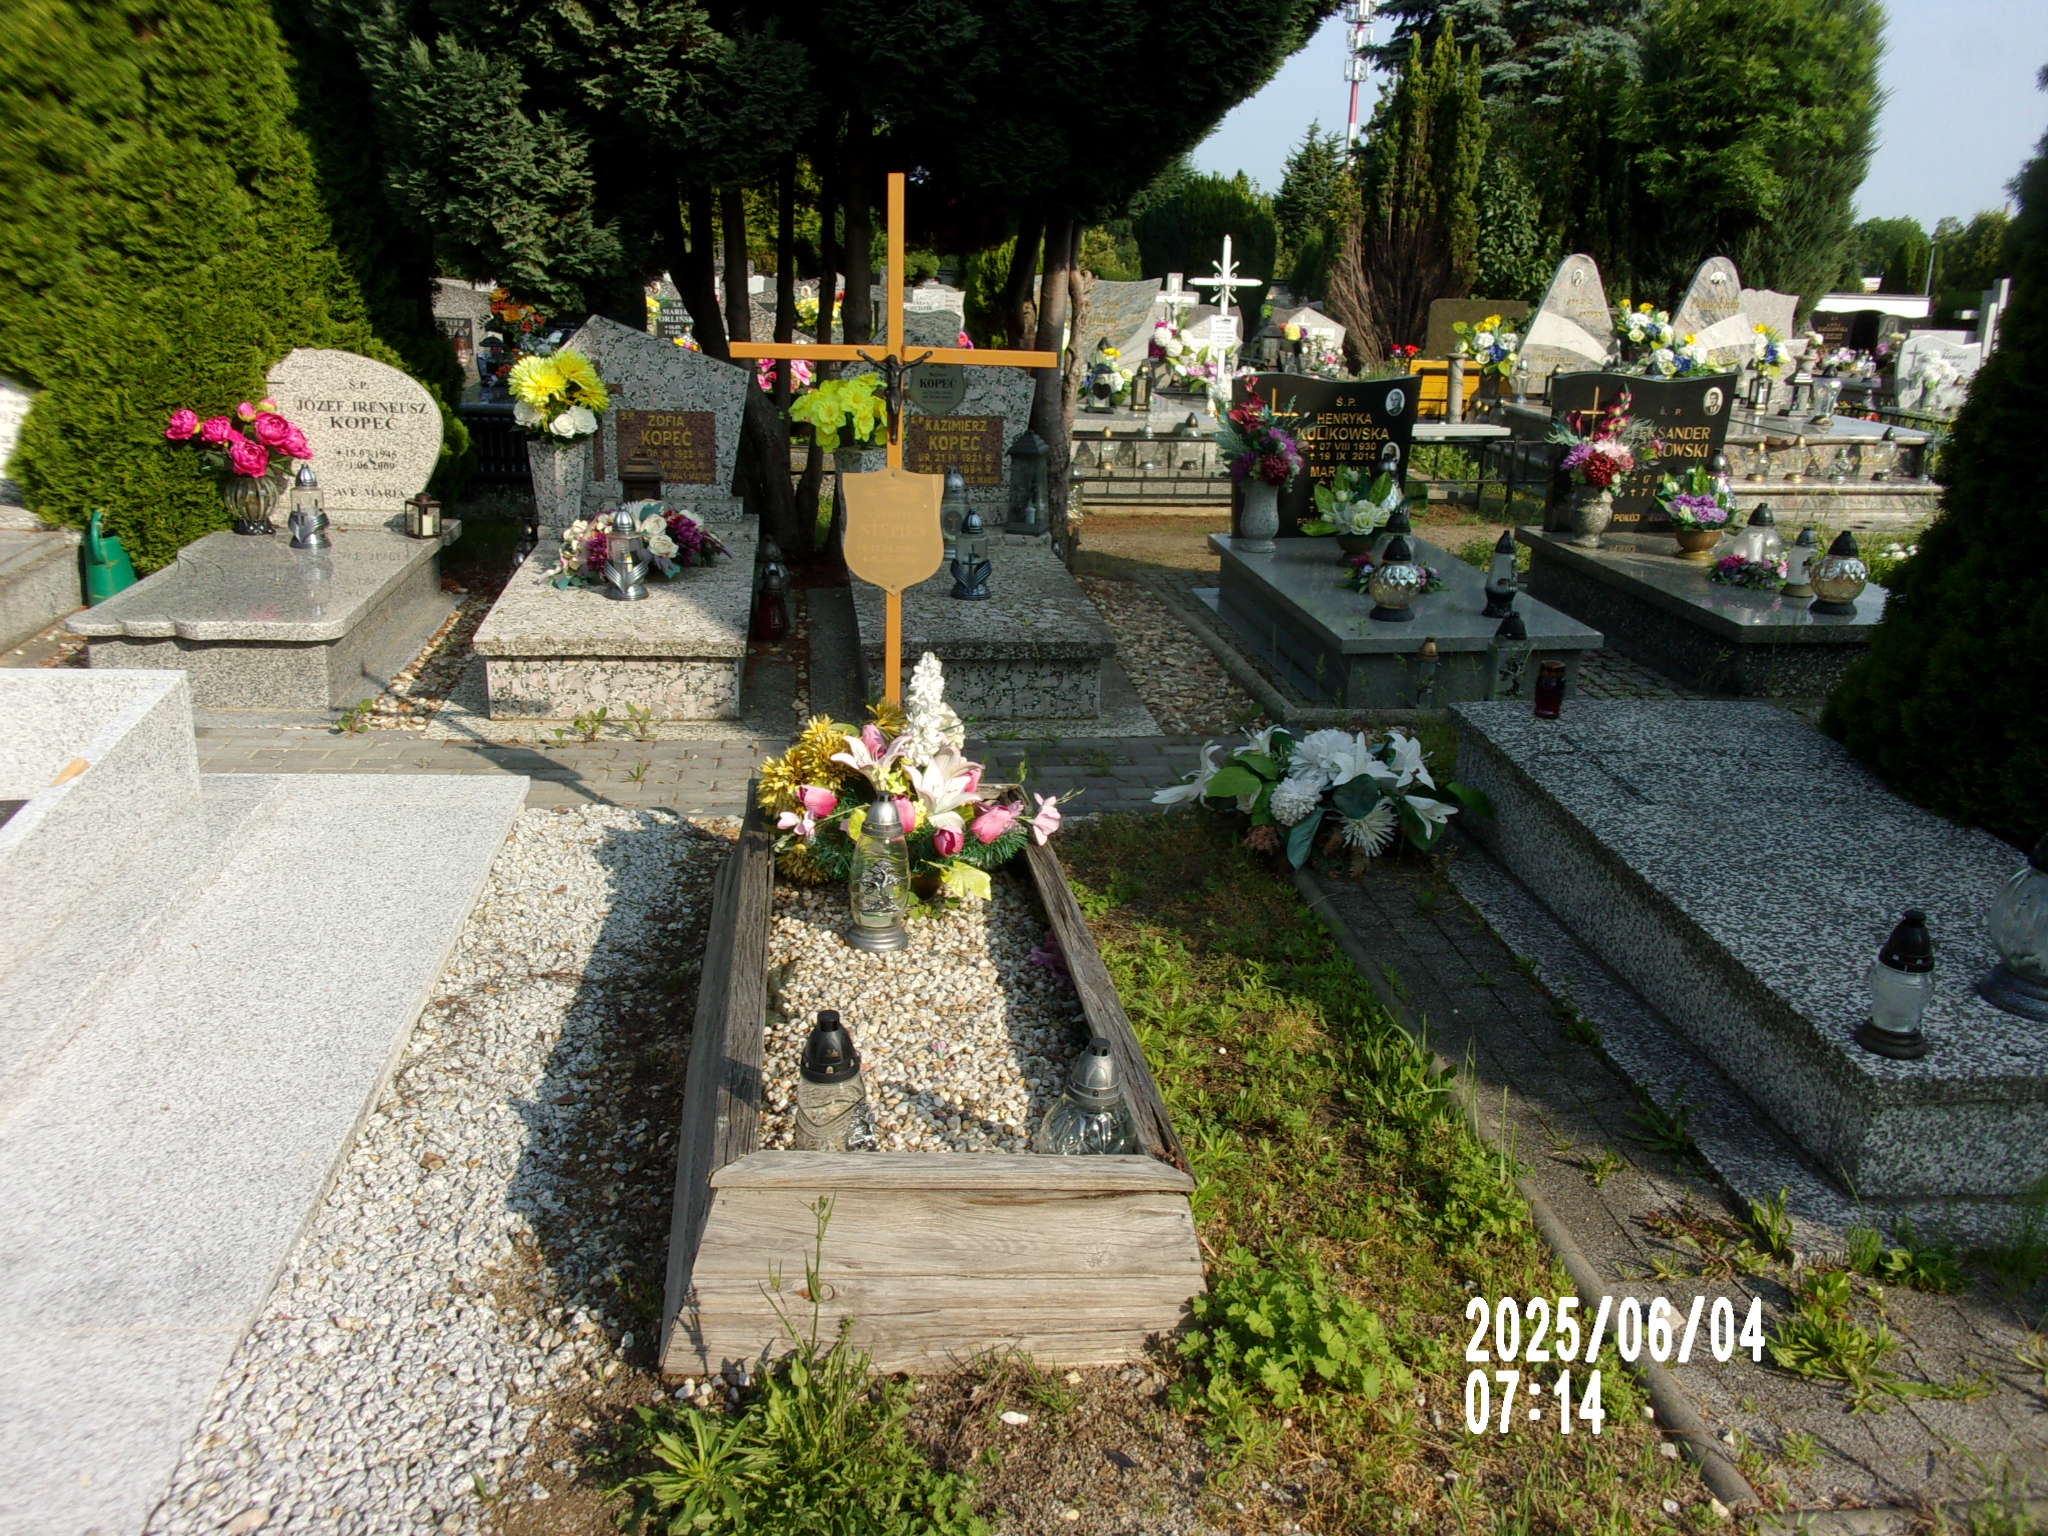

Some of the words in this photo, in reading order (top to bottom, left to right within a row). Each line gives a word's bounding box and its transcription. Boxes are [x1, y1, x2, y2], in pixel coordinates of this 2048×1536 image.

[352, 401, 428, 414] IRENEUSZ
[648, 415, 685, 427] ZOFIA
[1317, 413, 1373, 425] HENRYKA
[926, 420, 988, 431] KAZIMIERZ
[1297, 428, 1390, 440] KULIKOWSKA
[1353, 442, 1376, 450] 1930
[1351, 452, 1376, 460] 2014
